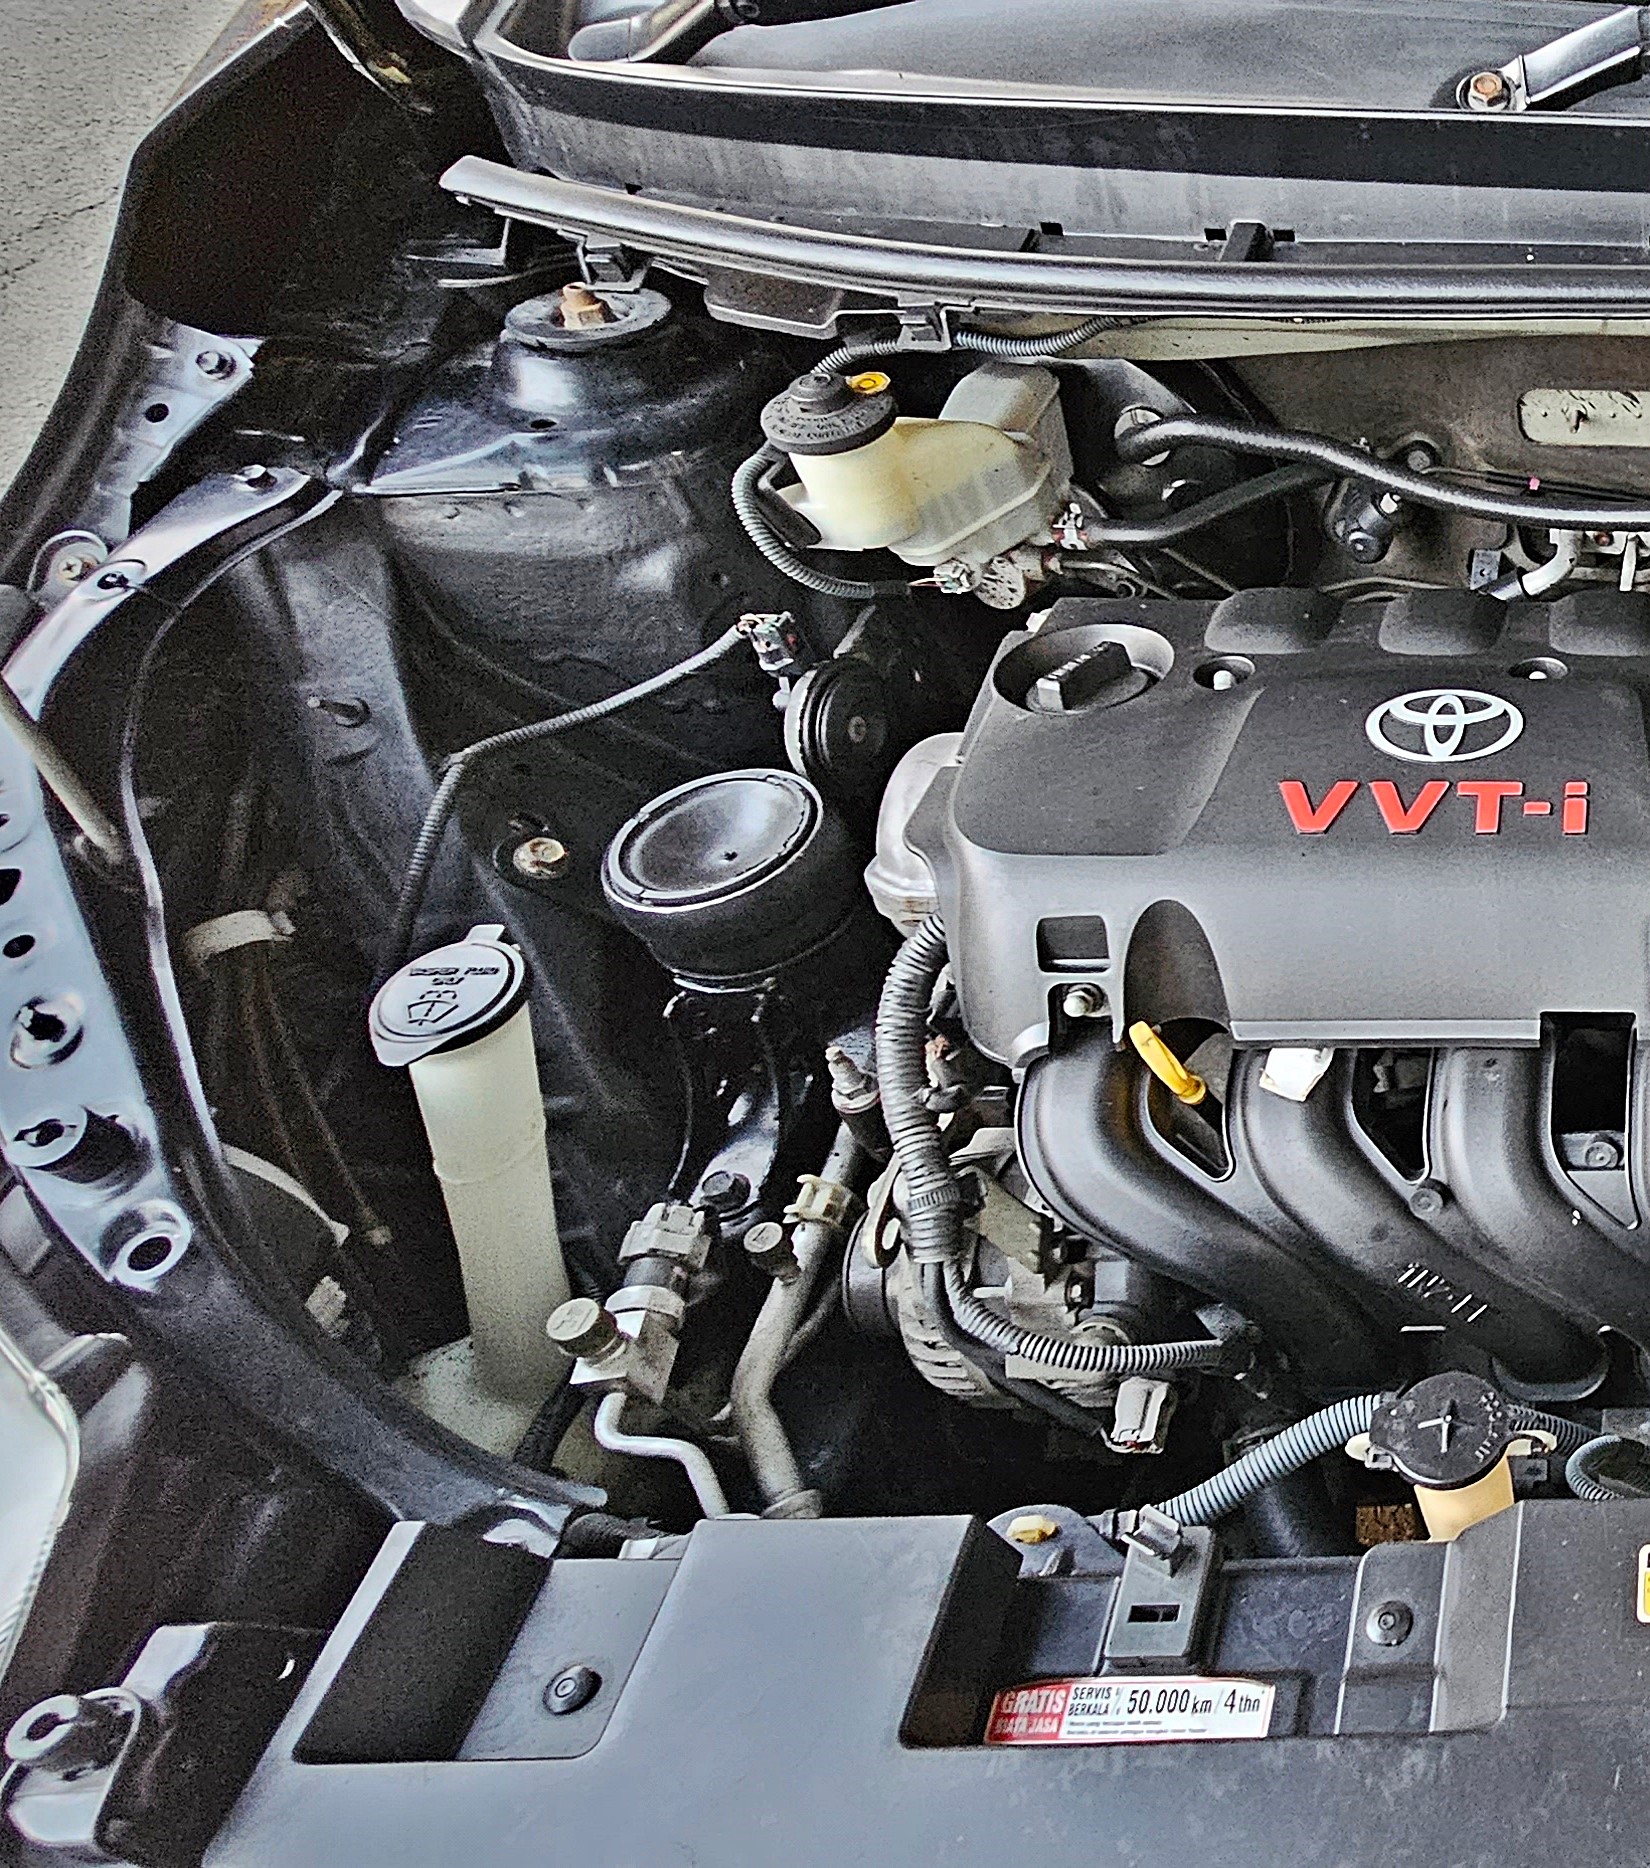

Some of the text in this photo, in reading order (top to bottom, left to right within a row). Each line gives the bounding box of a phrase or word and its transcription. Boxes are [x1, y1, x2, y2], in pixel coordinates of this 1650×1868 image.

[1278, 780, 1589, 834] VVT-i
[1001, 1689, 1067, 1714] GRATIS
[1072, 1687, 1113, 1701] SERVIS
[1127, 1689, 1190, 1714] 50.000
[1191, 1695, 1212, 1714] km
[1224, 1689, 1236, 1714] 4
[1068, 1703, 1110, 1716] BERKALA
[1029, 1716, 1060, 1733] JASA
